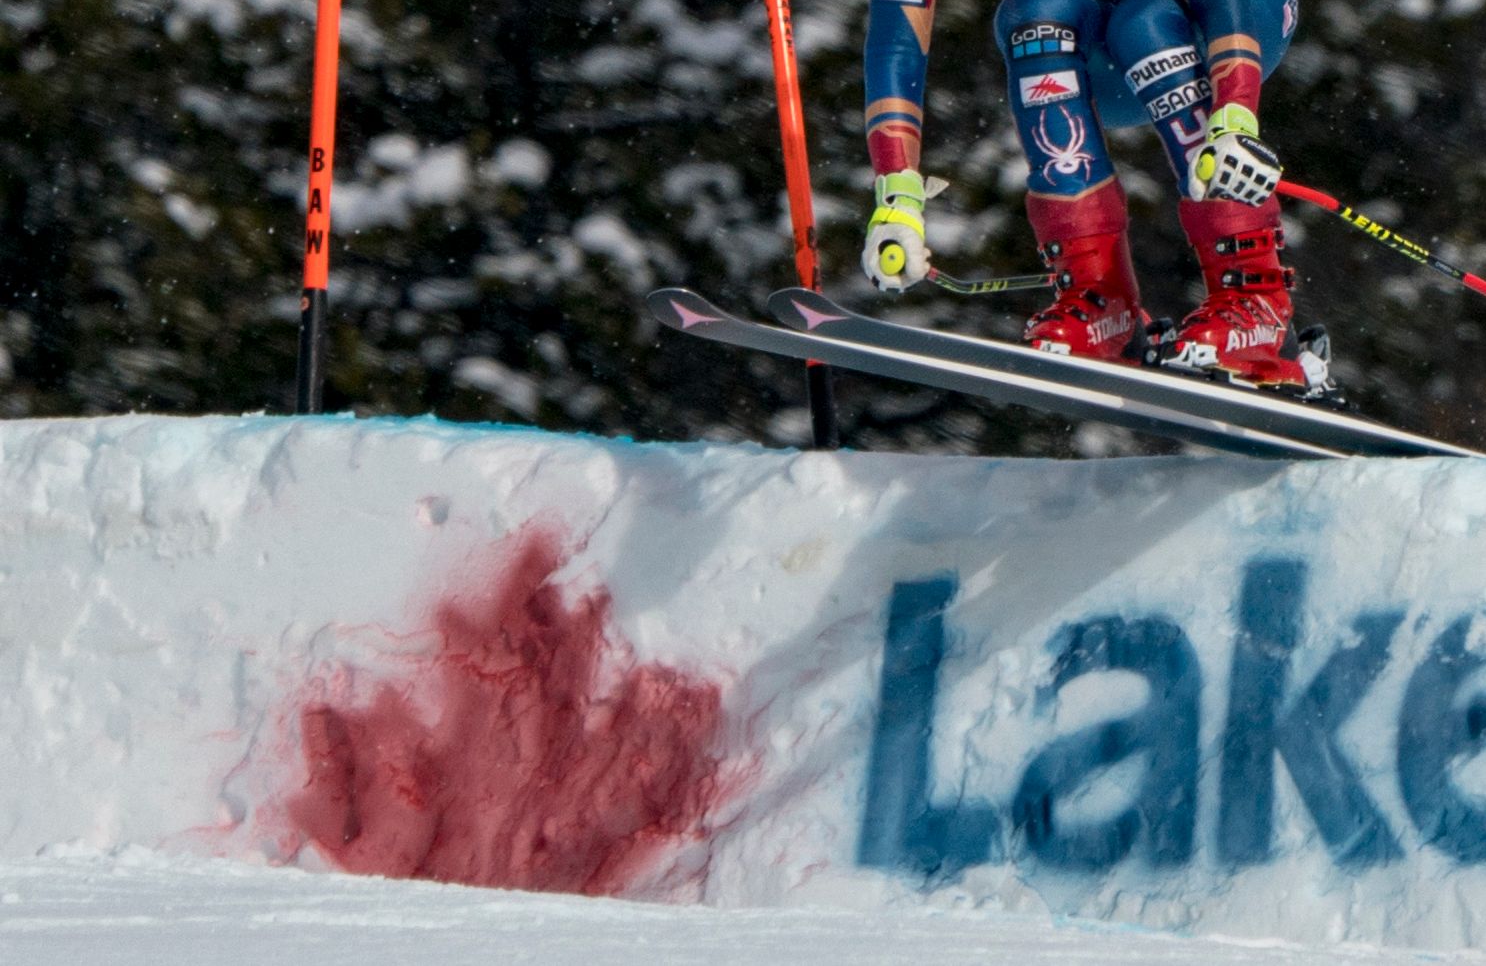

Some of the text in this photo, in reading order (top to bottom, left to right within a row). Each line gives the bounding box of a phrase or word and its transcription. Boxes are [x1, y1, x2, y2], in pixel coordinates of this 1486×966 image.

[1011, 24, 1075, 45] GoPro
[1130, 49, 1199, 87] Putnam
[1149, 78, 1212, 120] USANA
